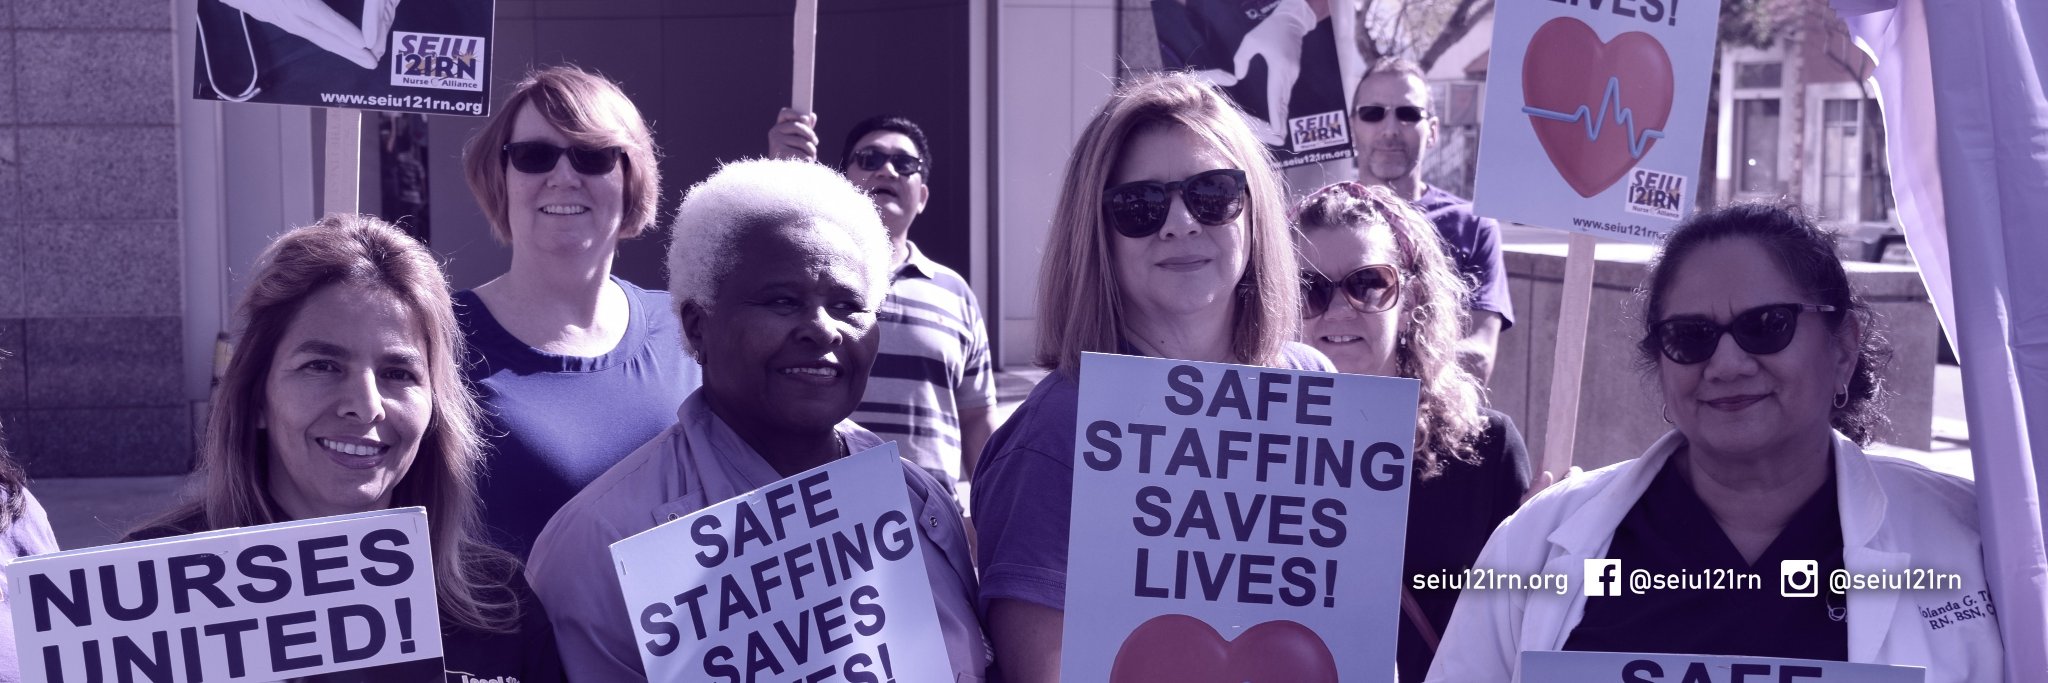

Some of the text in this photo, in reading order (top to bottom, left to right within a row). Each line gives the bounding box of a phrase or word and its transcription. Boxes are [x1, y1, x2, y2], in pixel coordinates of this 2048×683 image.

[401, 34, 477, 58] SEIU
[321, 92, 483, 115] www.seiu121rn.org
[402, 77, 478, 89] Nurse Alliance
[1295, 112, 1339, 131] SEIU
[1634, 169, 1683, 192] SEIU
[1164, 364, 1335, 426] SAFE
[1082, 419, 1406, 492] STAFFING
[690, 470, 840, 569] SAFE
[1132, 485, 1348, 548] SAVES
[28, 528, 415, 632] NURSES
[639, 509, 915, 657] STAFFING
[1134, 547, 1338, 608] LIVES!
[1917, 601, 1960, 618] olanda
[1962, 595, 1977, 607] G.
[42, 597, 416, 683] UNITED!
[702, 585, 886, 683] SAVES
[1929, 614, 1954, 630] RN,
[1954, 606, 1986, 621] BSN,
